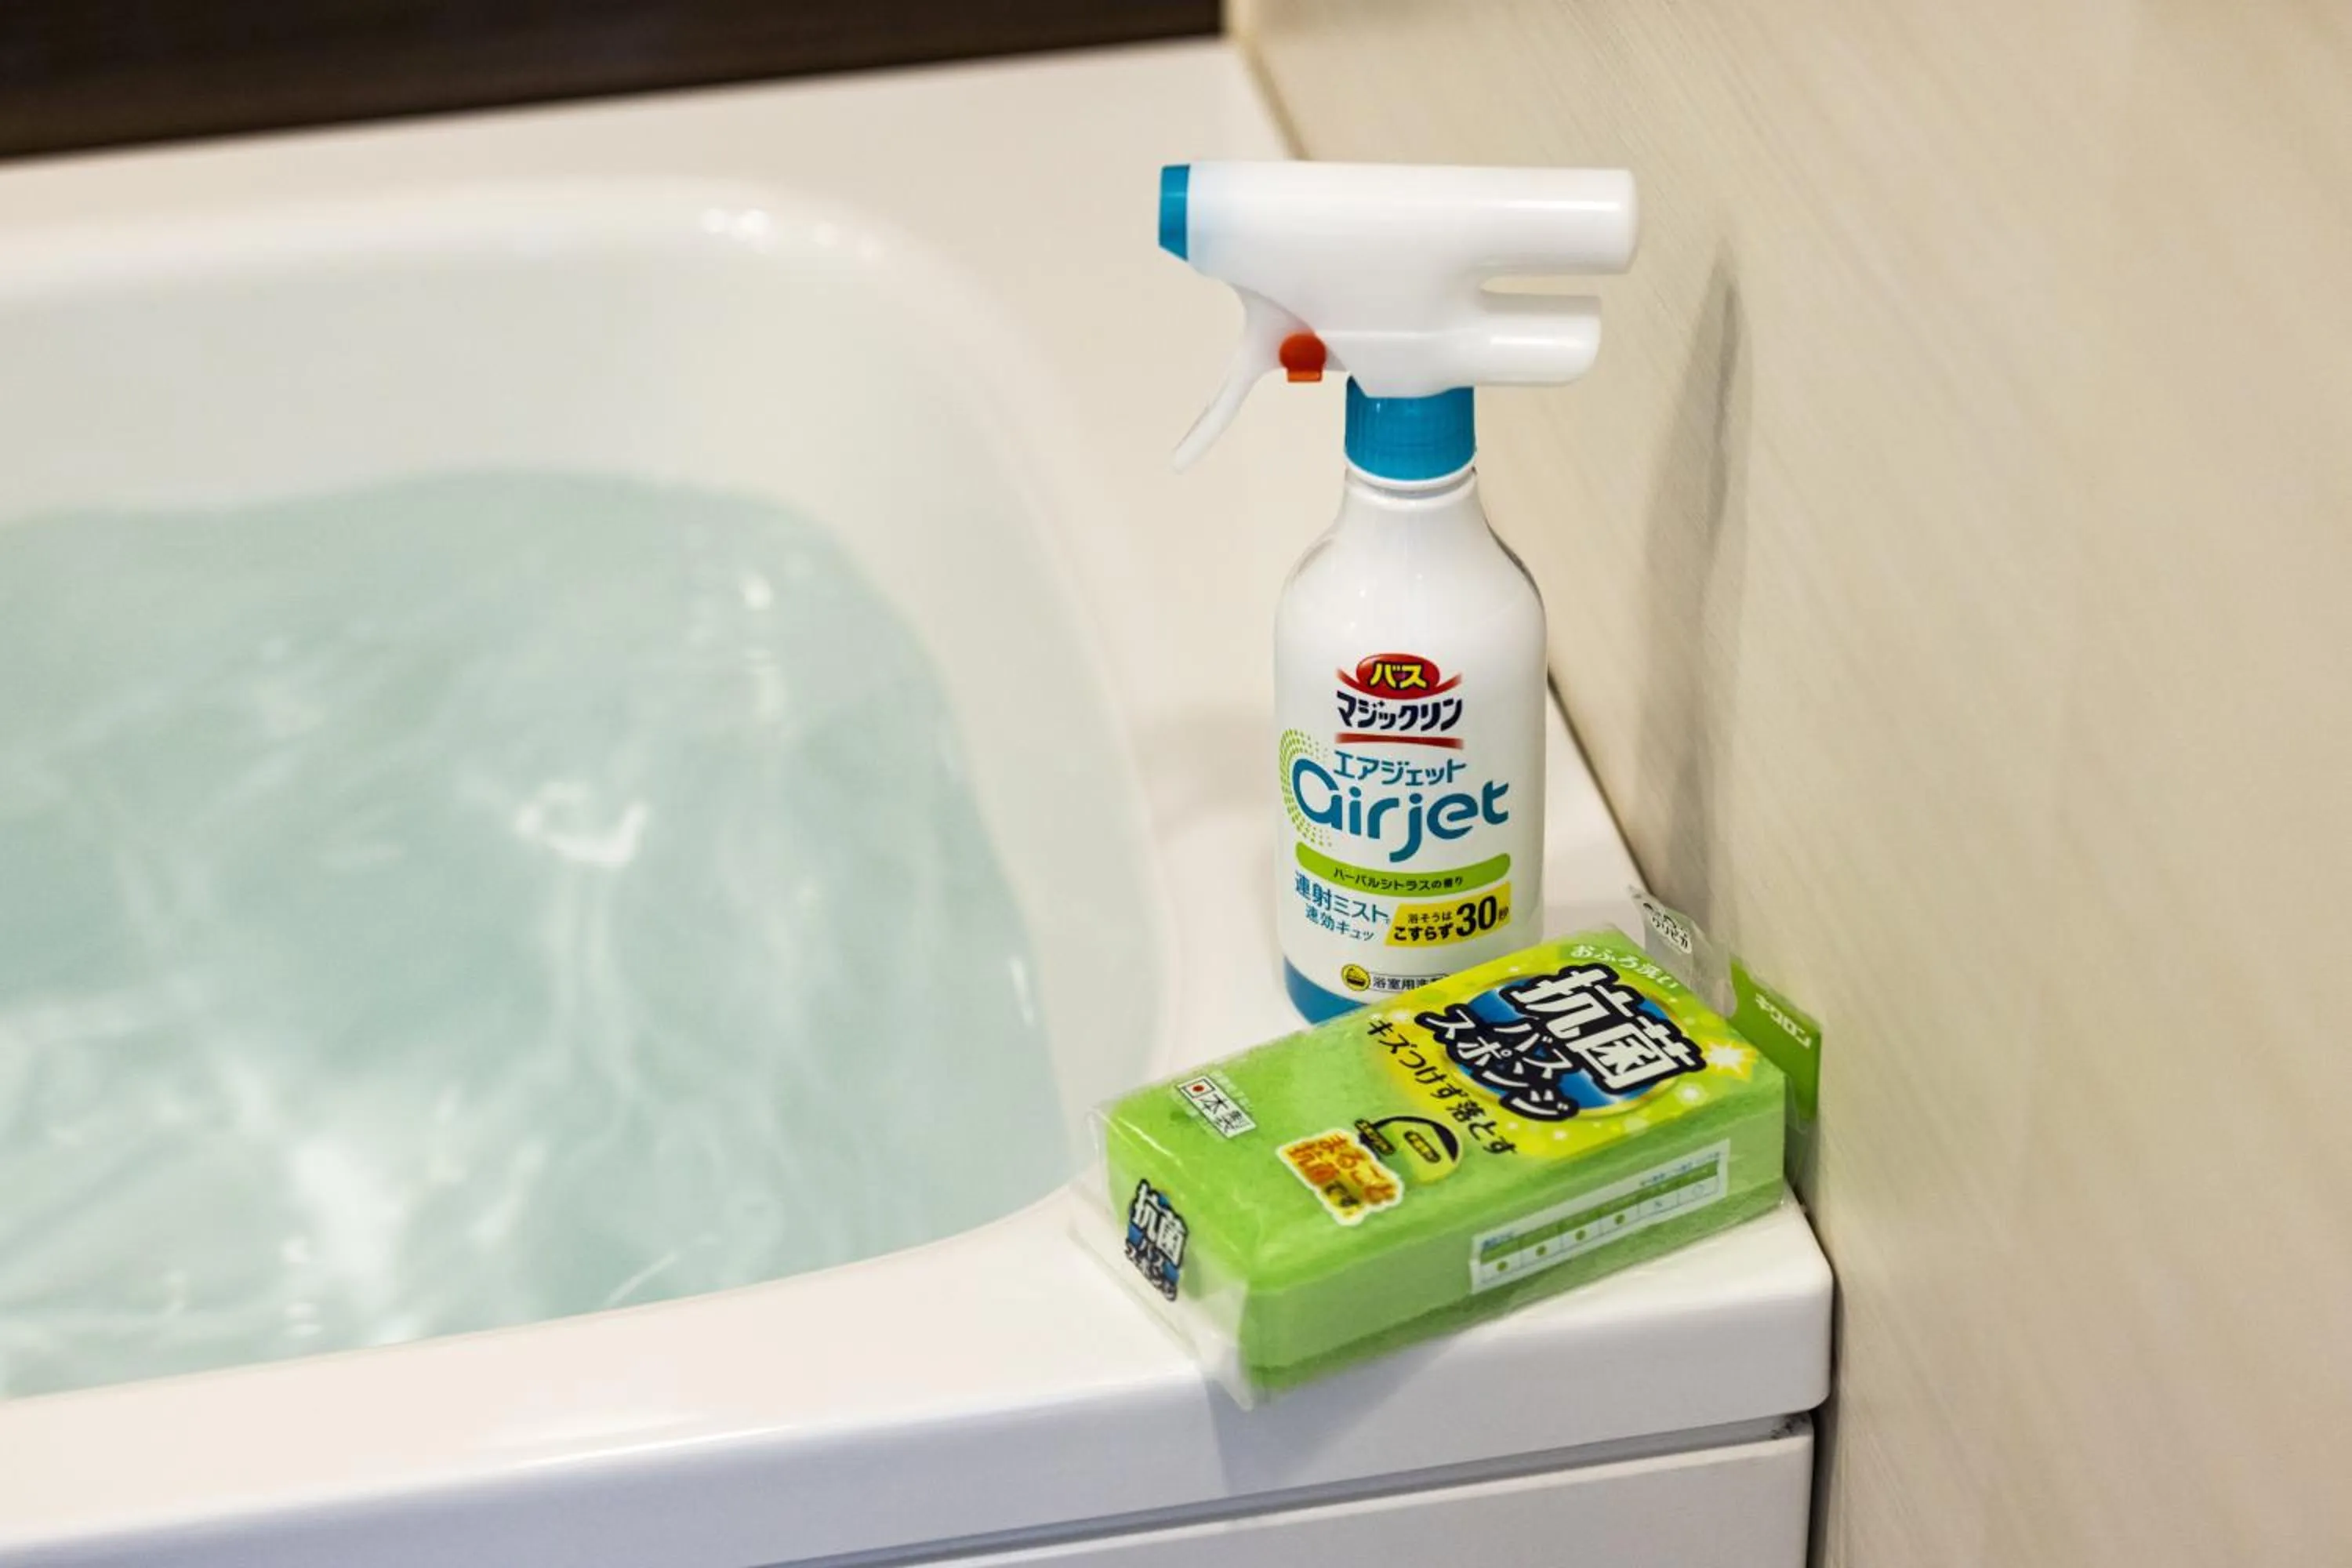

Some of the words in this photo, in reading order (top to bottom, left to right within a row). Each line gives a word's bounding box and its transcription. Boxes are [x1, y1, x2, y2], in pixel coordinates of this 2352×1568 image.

[1336, 690, 1463, 731] マジックリン
[1370, 662, 1427, 689] バス
[1334, 750, 1466, 786] エアジェット
[1425, 1008, 1570, 1116] スポンジ
[1494, 1022, 1573, 1080] バス
[1511, 968, 1696, 1089] 抗菌
[1367, 1021, 1516, 1154] キズつけず落とす
[1131, 1181, 1186, 1268] 抗菌
